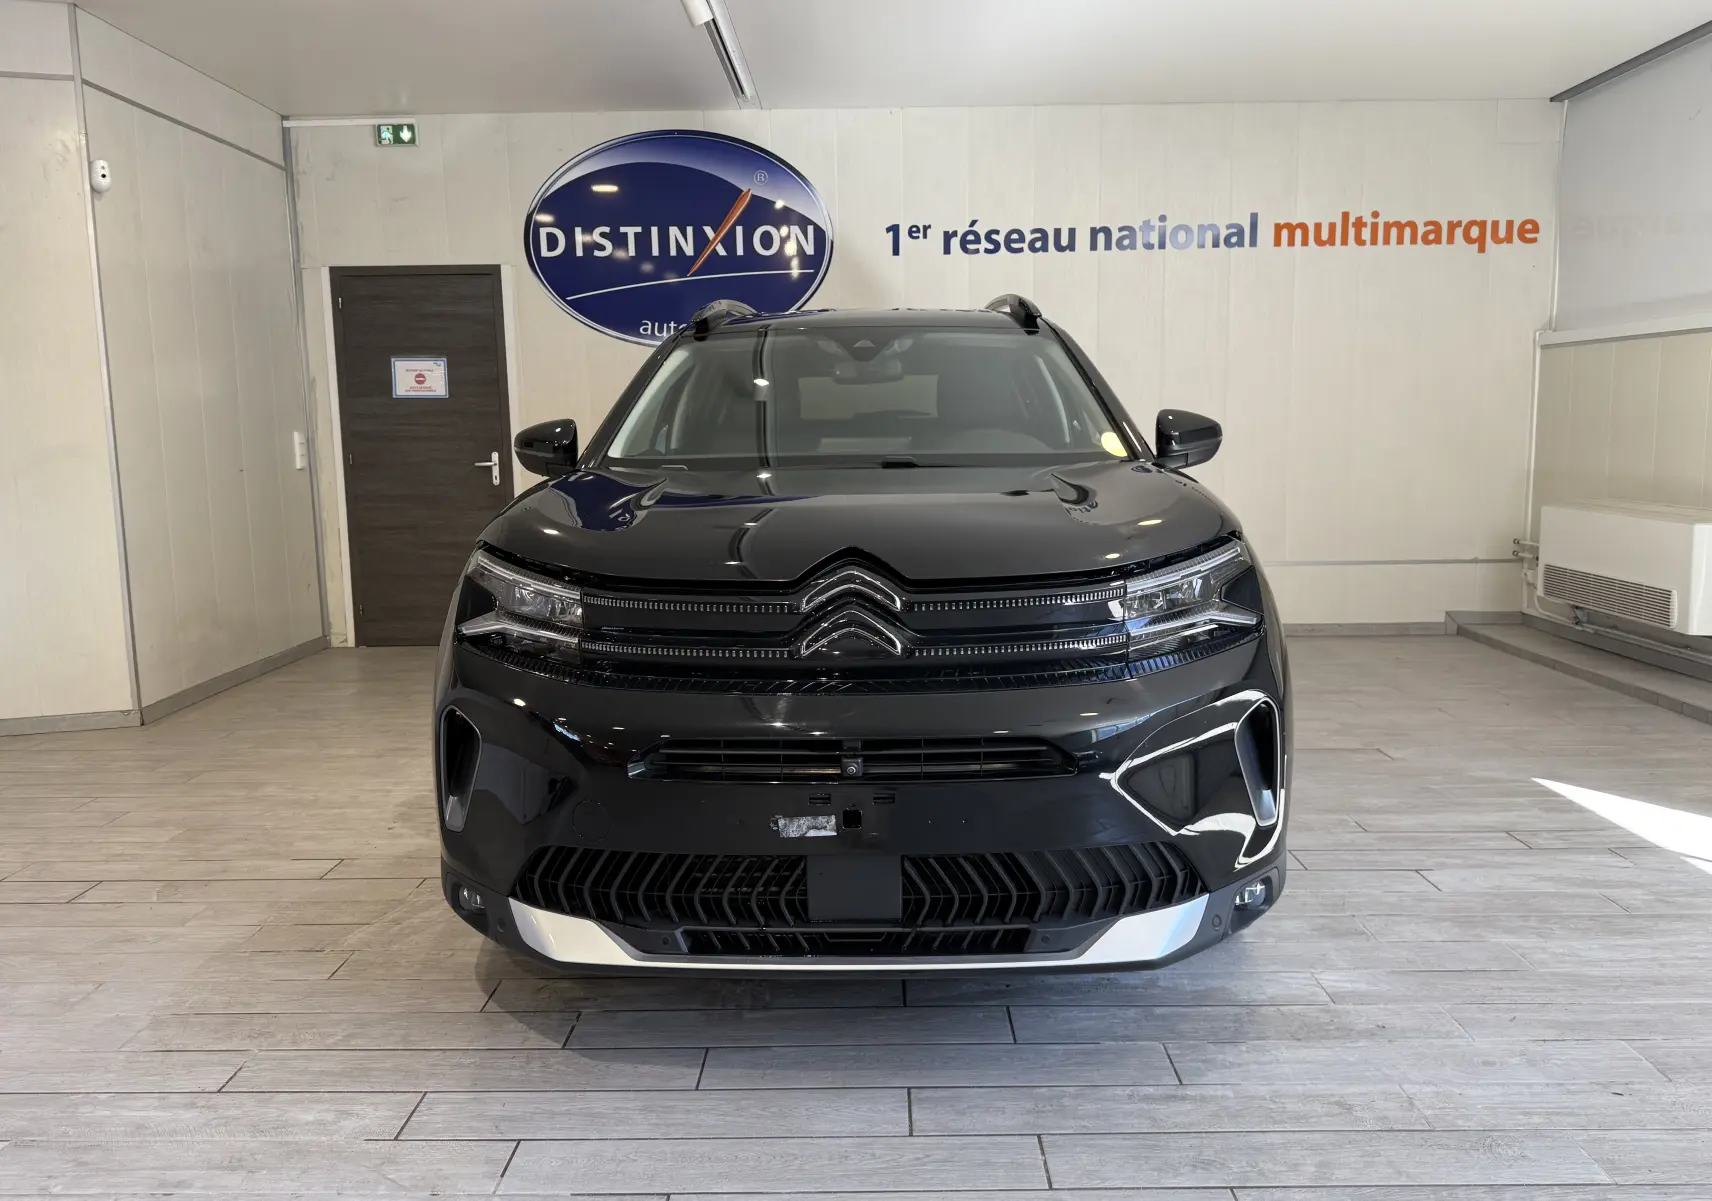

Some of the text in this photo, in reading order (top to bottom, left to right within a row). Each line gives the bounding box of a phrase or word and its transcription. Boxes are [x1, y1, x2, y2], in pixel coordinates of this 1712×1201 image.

[539, 225, 815, 257] DISTINXION
[942, 219, 1076, 255] réseau
[1089, 212, 1258, 251] national
[1273, 210, 1539, 253] multimarque
